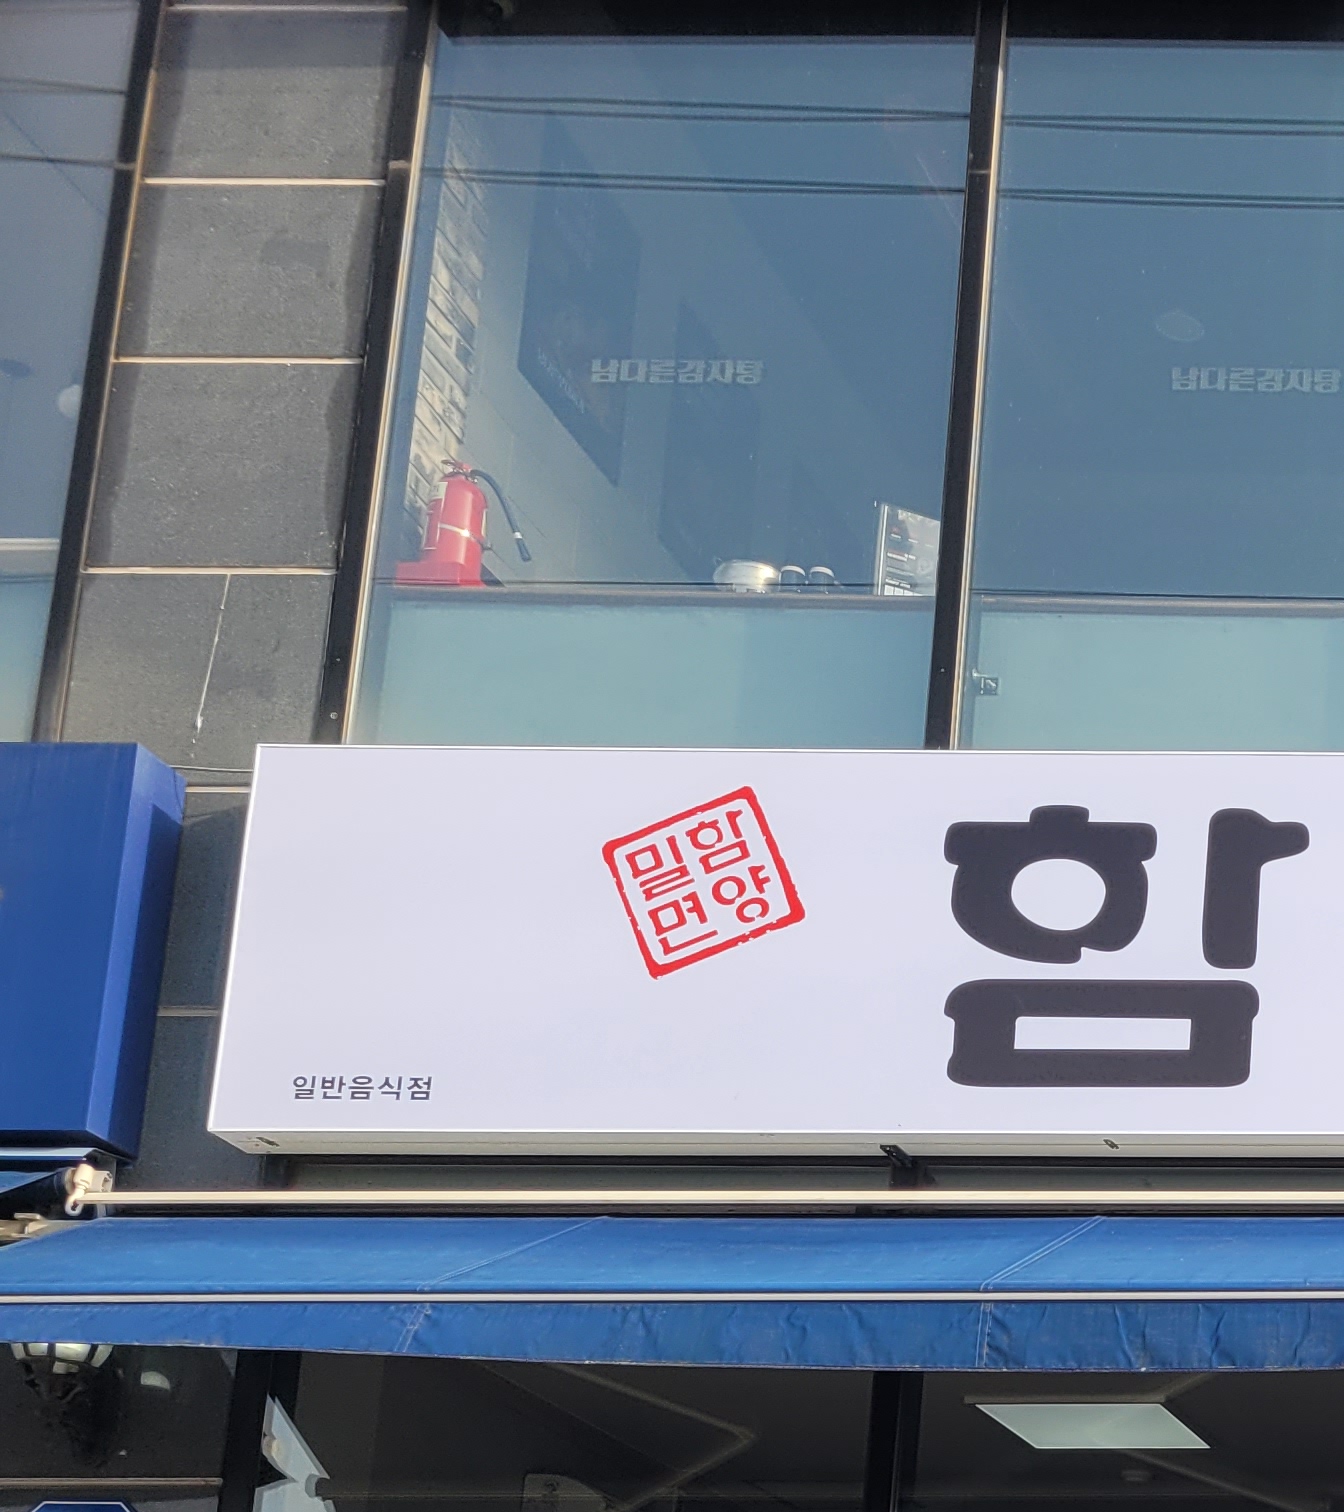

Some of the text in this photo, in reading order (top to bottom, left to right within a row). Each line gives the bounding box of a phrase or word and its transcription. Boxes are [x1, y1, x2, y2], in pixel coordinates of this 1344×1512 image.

[591, 359, 763, 384] 남다른감자탕
[1171, 366, 1343, 393] 남다른감자탕
[292, 1074, 434, 1101] 일반음식점
